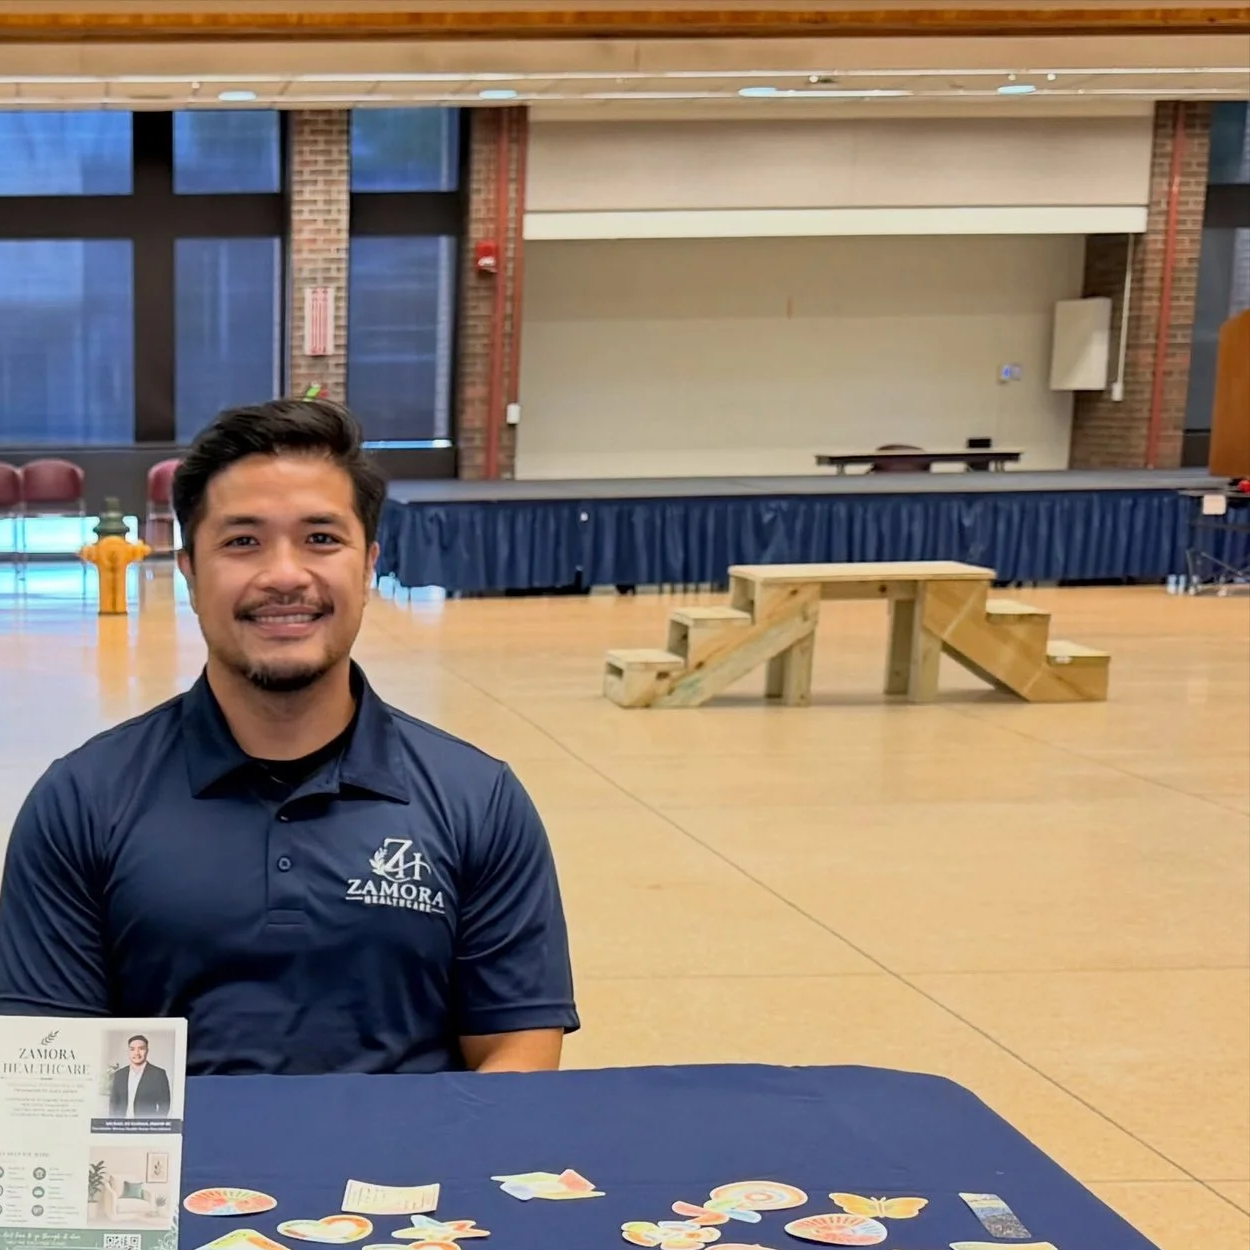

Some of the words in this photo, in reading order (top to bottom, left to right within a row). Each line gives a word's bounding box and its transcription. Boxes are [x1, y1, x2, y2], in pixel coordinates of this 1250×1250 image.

[347, 878, 445, 908] ZAMORA
[364, 895, 432, 913] HEALTHCARE
[18, 1048, 76, 1060] ZAMORA
